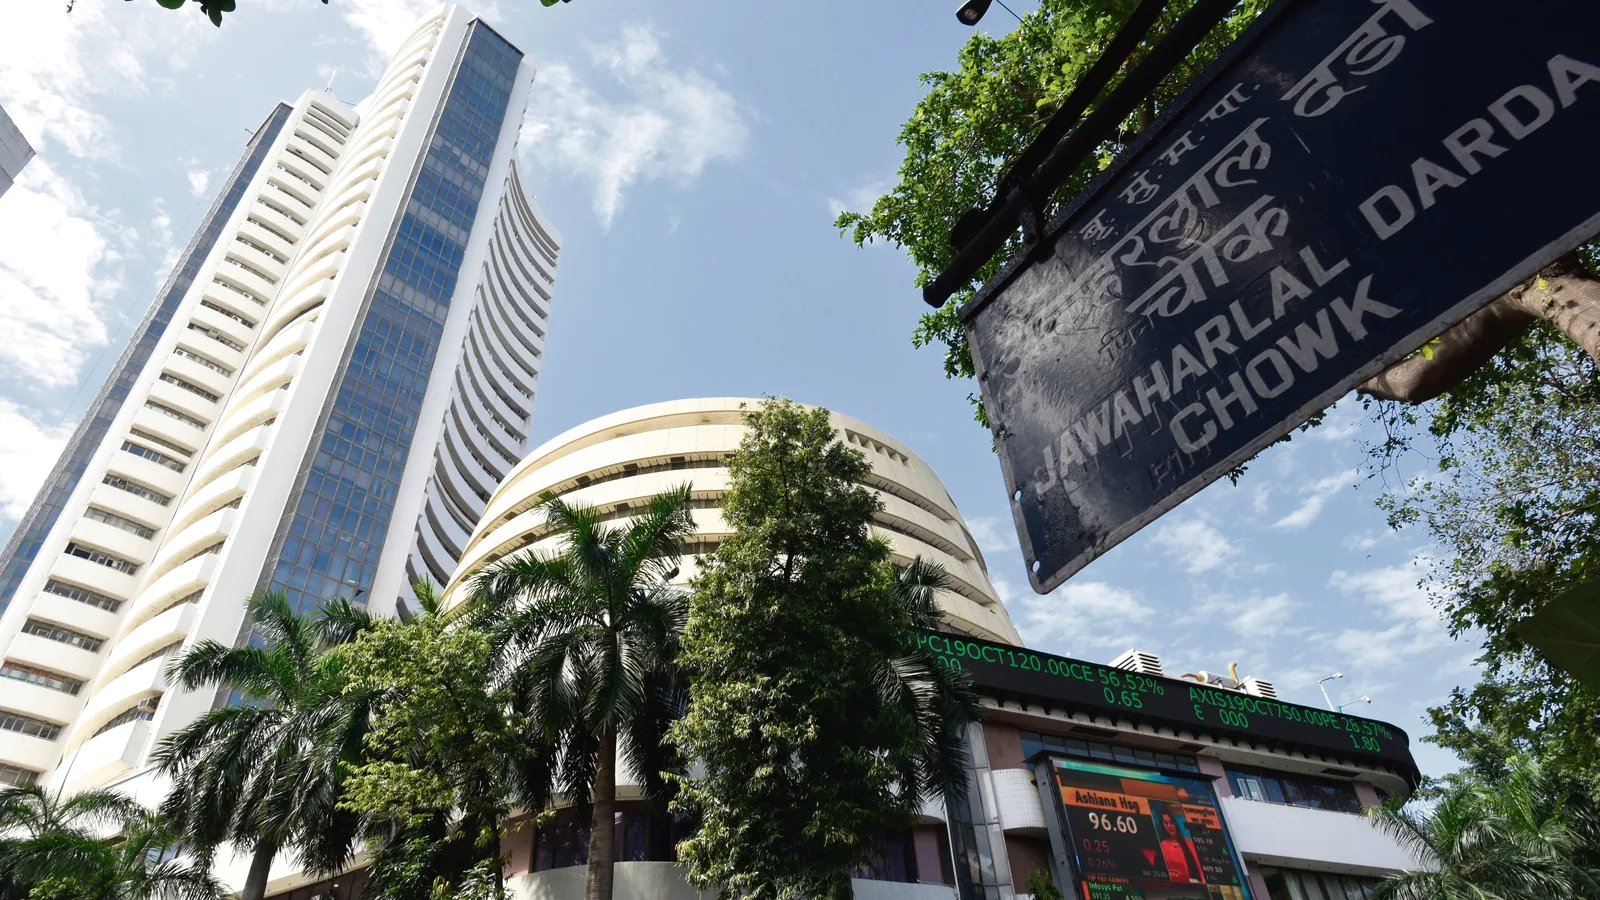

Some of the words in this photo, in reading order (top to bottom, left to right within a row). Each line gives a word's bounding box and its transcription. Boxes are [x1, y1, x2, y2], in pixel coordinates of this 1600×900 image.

[1034, 245, 1351, 496] JAWAHARLAL
[1358, 54, 1600, 241] DARDA
[1169, 273, 1404, 453] CHOWK
[1098, 668, 1165, 696] 56.52%
[1103, 687, 1143, 709] 0.65
[1189, 686, 1341, 730] AXIS19OCT750.00PE
[1341, 717, 1392, 740] 28.57%
[1350, 734, 1380, 752] 1.80
[1075, 790, 1117, 808] Ashiana
[1119, 796, 1140, 814] Hsg
[1089, 812, 1138, 834] 96.60
[1083, 838, 1110, 853] 0.25
